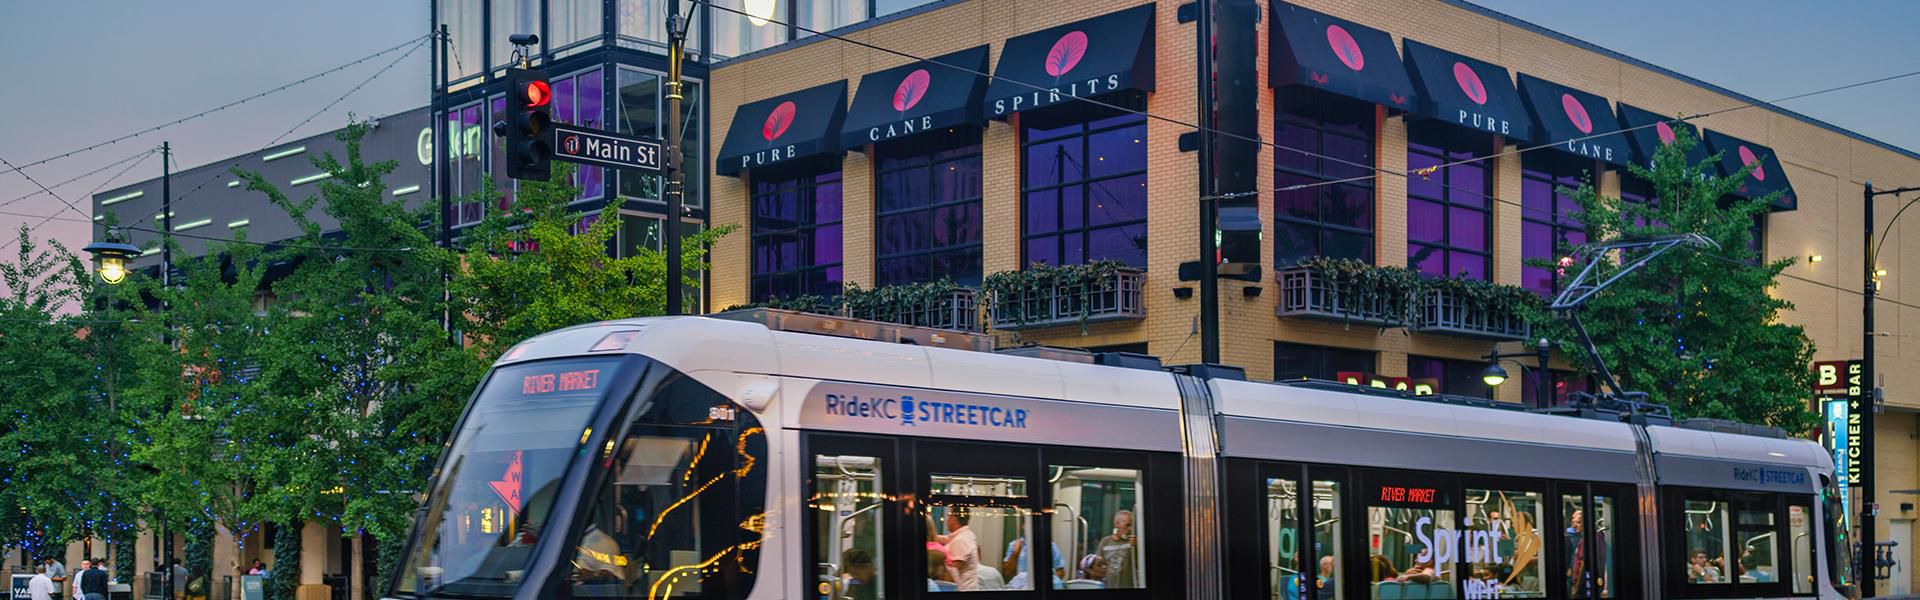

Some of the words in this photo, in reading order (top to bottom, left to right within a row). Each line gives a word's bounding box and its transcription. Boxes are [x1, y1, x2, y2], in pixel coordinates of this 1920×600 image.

[995, 74, 1118, 114] SPIRITS
[869, 116, 932, 141] CANE
[1459, 109, 1510, 135] PURE
[586, 138, 630, 161] Main
[637, 146, 655, 165] St
[742, 145, 796, 168] PURE
[1568, 138, 1613, 161] CANE
[523, 374, 555, 394] RIVER
[559, 369, 599, 391] MARKET
[1849, 364, 1861, 396] BAR
[825, 393, 897, 419] RideKC
[918, 401, 1027, 428] STREETCAR
[1848, 414, 1860, 484] KITCHEN
[1381, 486, 1406, 501] RIVER
[1407, 488, 1436, 503] MARKET
[1415, 516, 1503, 577] Sprint
